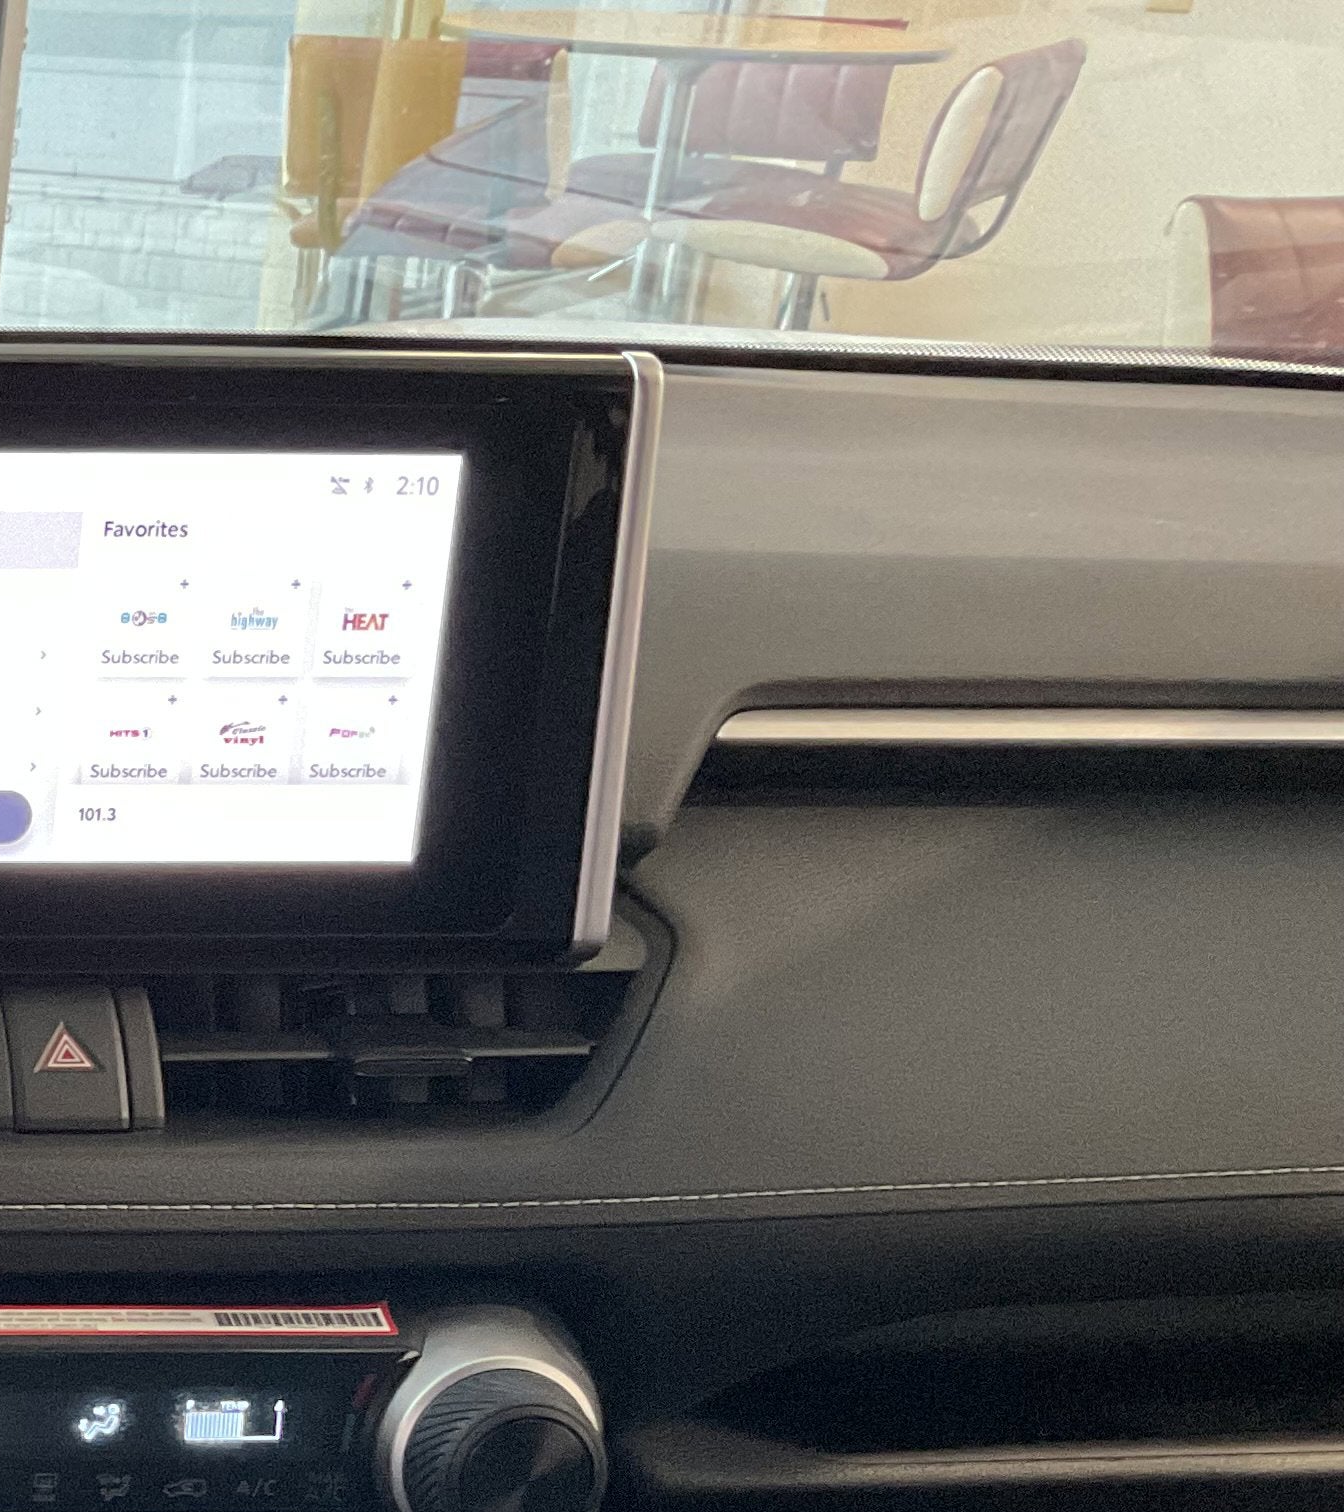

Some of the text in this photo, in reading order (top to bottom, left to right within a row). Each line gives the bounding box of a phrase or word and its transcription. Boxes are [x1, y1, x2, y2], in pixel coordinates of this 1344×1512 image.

[396, 477, 440, 496] 2:10
[103, 520, 188, 538] Favorites
[230, 611, 279, 631] highway
[342, 613, 389, 631] HEAT
[101, 650, 180, 665] Subscribe
[212, 650, 291, 665] Subscribe
[322, 650, 401, 665] Subscribe
[223, 735, 265, 746] vinyl
[90, 763, 168, 778] Subscribe
[200, 763, 278, 778] Subscribe
[309, 763, 387, 778] Subscribe
[78, 807, 117, 822] 101.3
